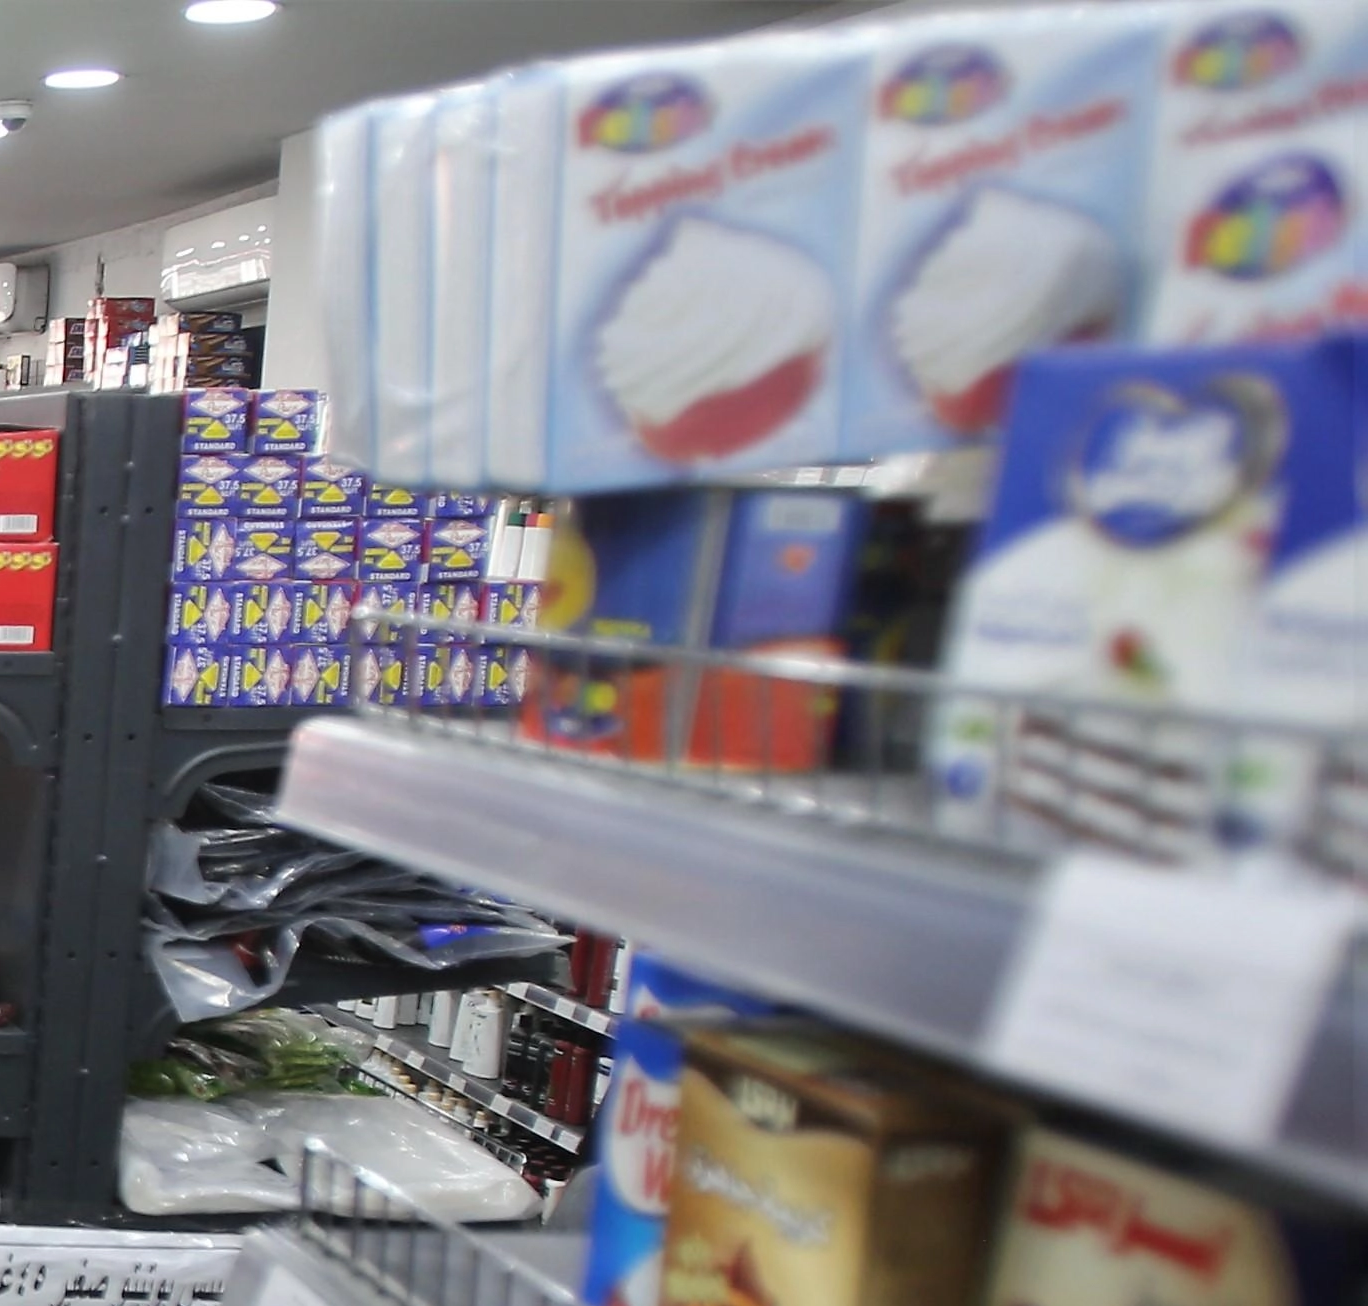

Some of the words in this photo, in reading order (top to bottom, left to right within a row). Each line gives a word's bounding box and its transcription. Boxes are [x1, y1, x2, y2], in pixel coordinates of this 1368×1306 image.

[224, 413, 246, 424] 37.5
[295, 413, 316, 424] 37.5
[264, 442, 306, 451] STANDARD
[219, 480, 239, 490] 37.5
[277, 480, 298, 490] 37.5
[341, 477, 362, 488] 37.5
[400, 544, 421, 554] 37.5
[370, 572, 411, 581] STANDARD
